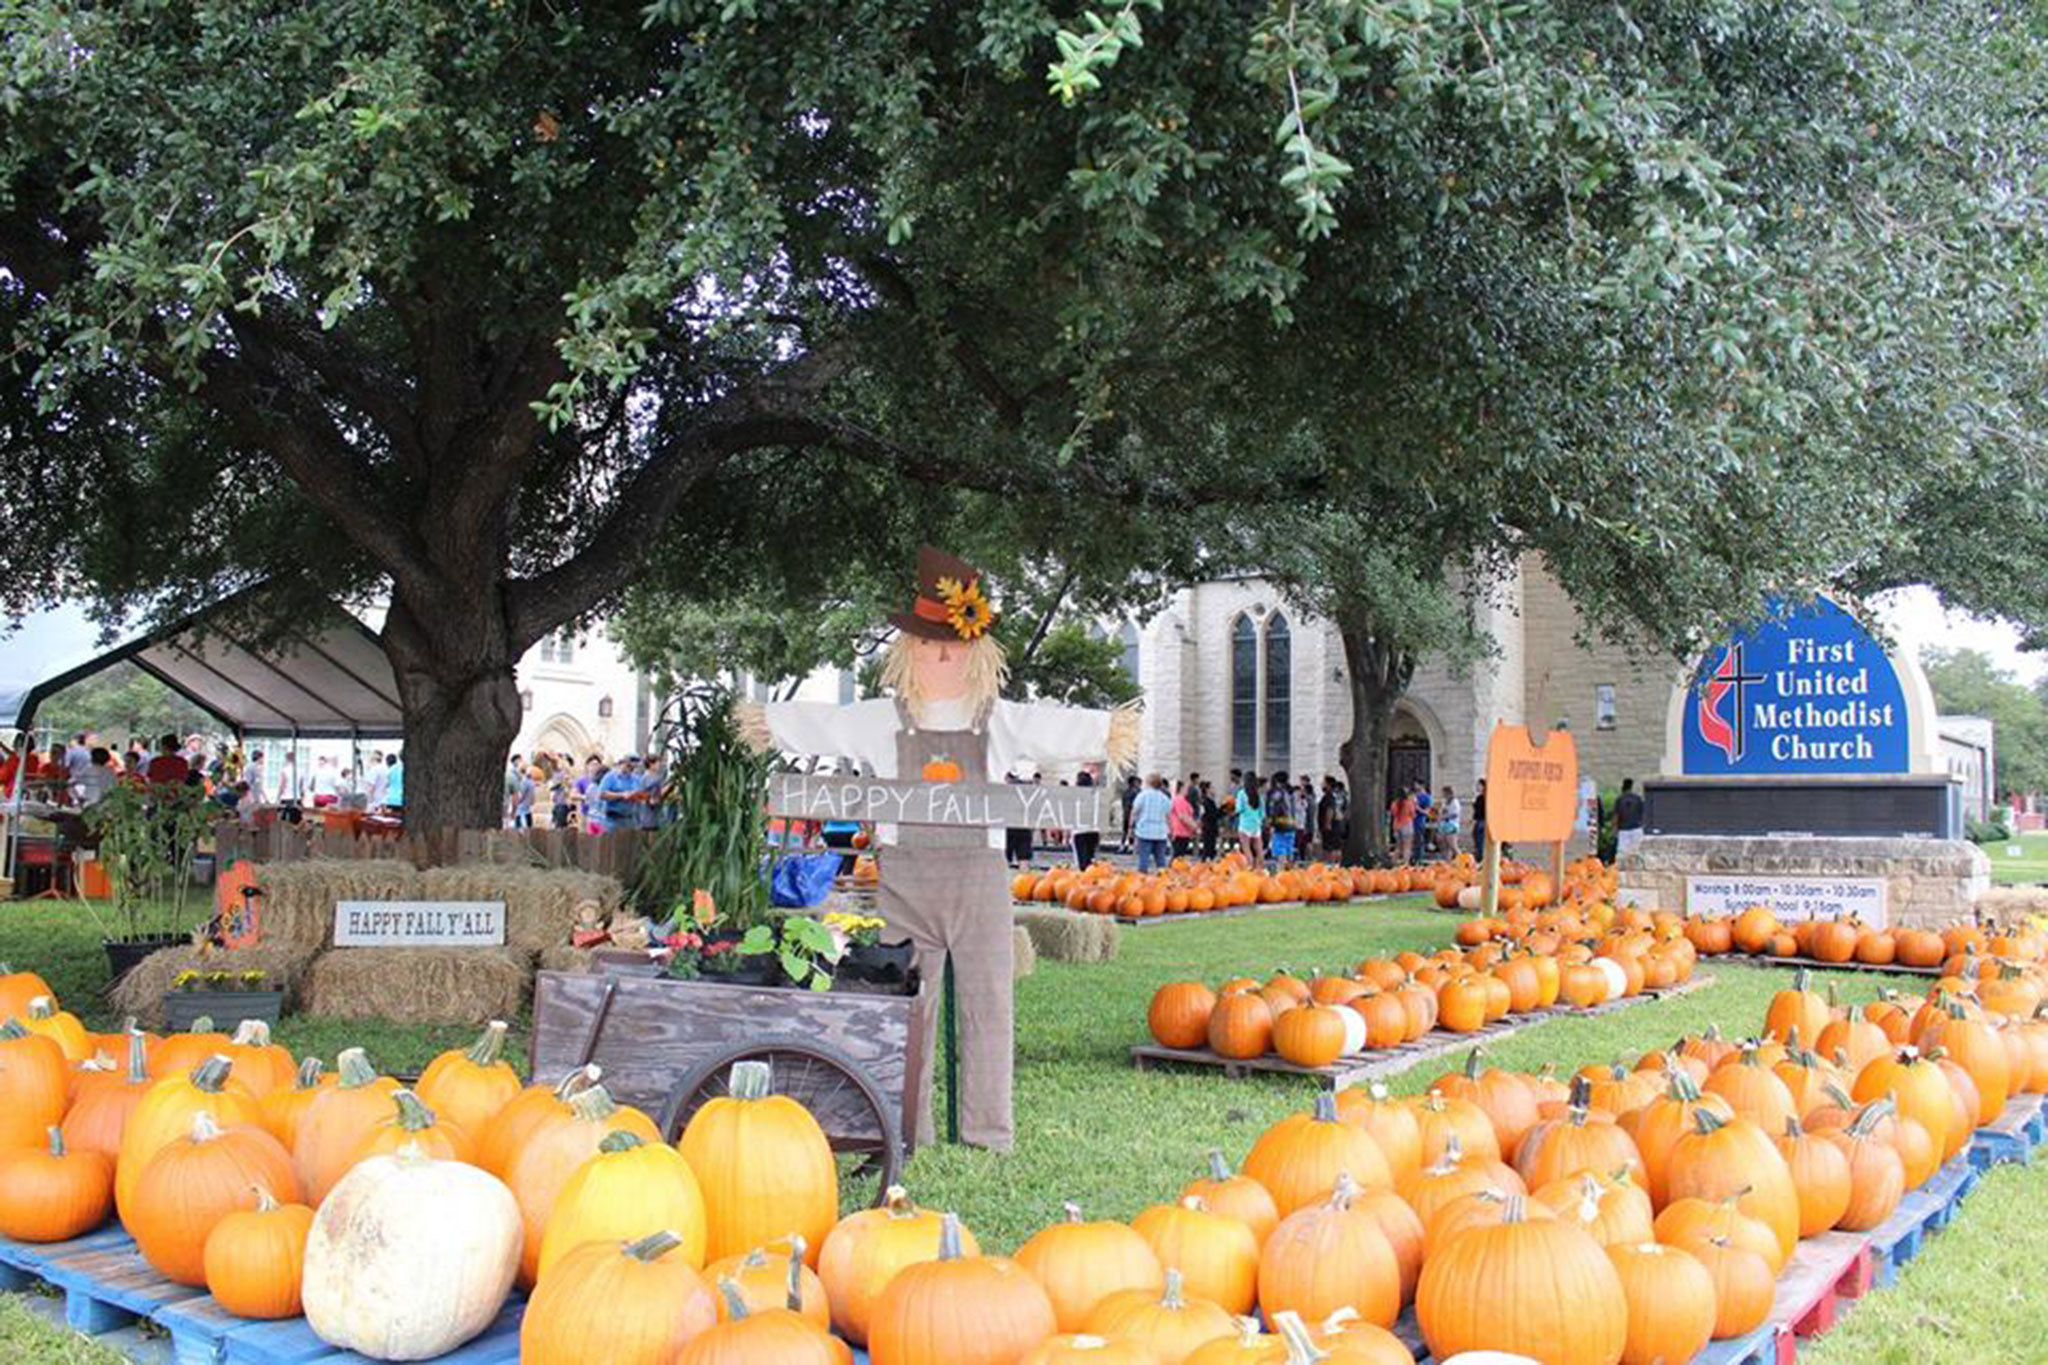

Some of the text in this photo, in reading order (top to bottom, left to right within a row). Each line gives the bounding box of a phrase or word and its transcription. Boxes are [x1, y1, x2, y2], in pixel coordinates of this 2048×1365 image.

[1788, 638, 1855, 663] First
[1776, 668, 1868, 696] United
[1753, 701, 1894, 728] Methodist
[1771, 733, 1873, 760] Church
[782, 780, 914, 819] HAPPY
[927, 783, 1003, 824] FALL
[349, 912, 495, 935] HAPPY FALL Y'ALL
